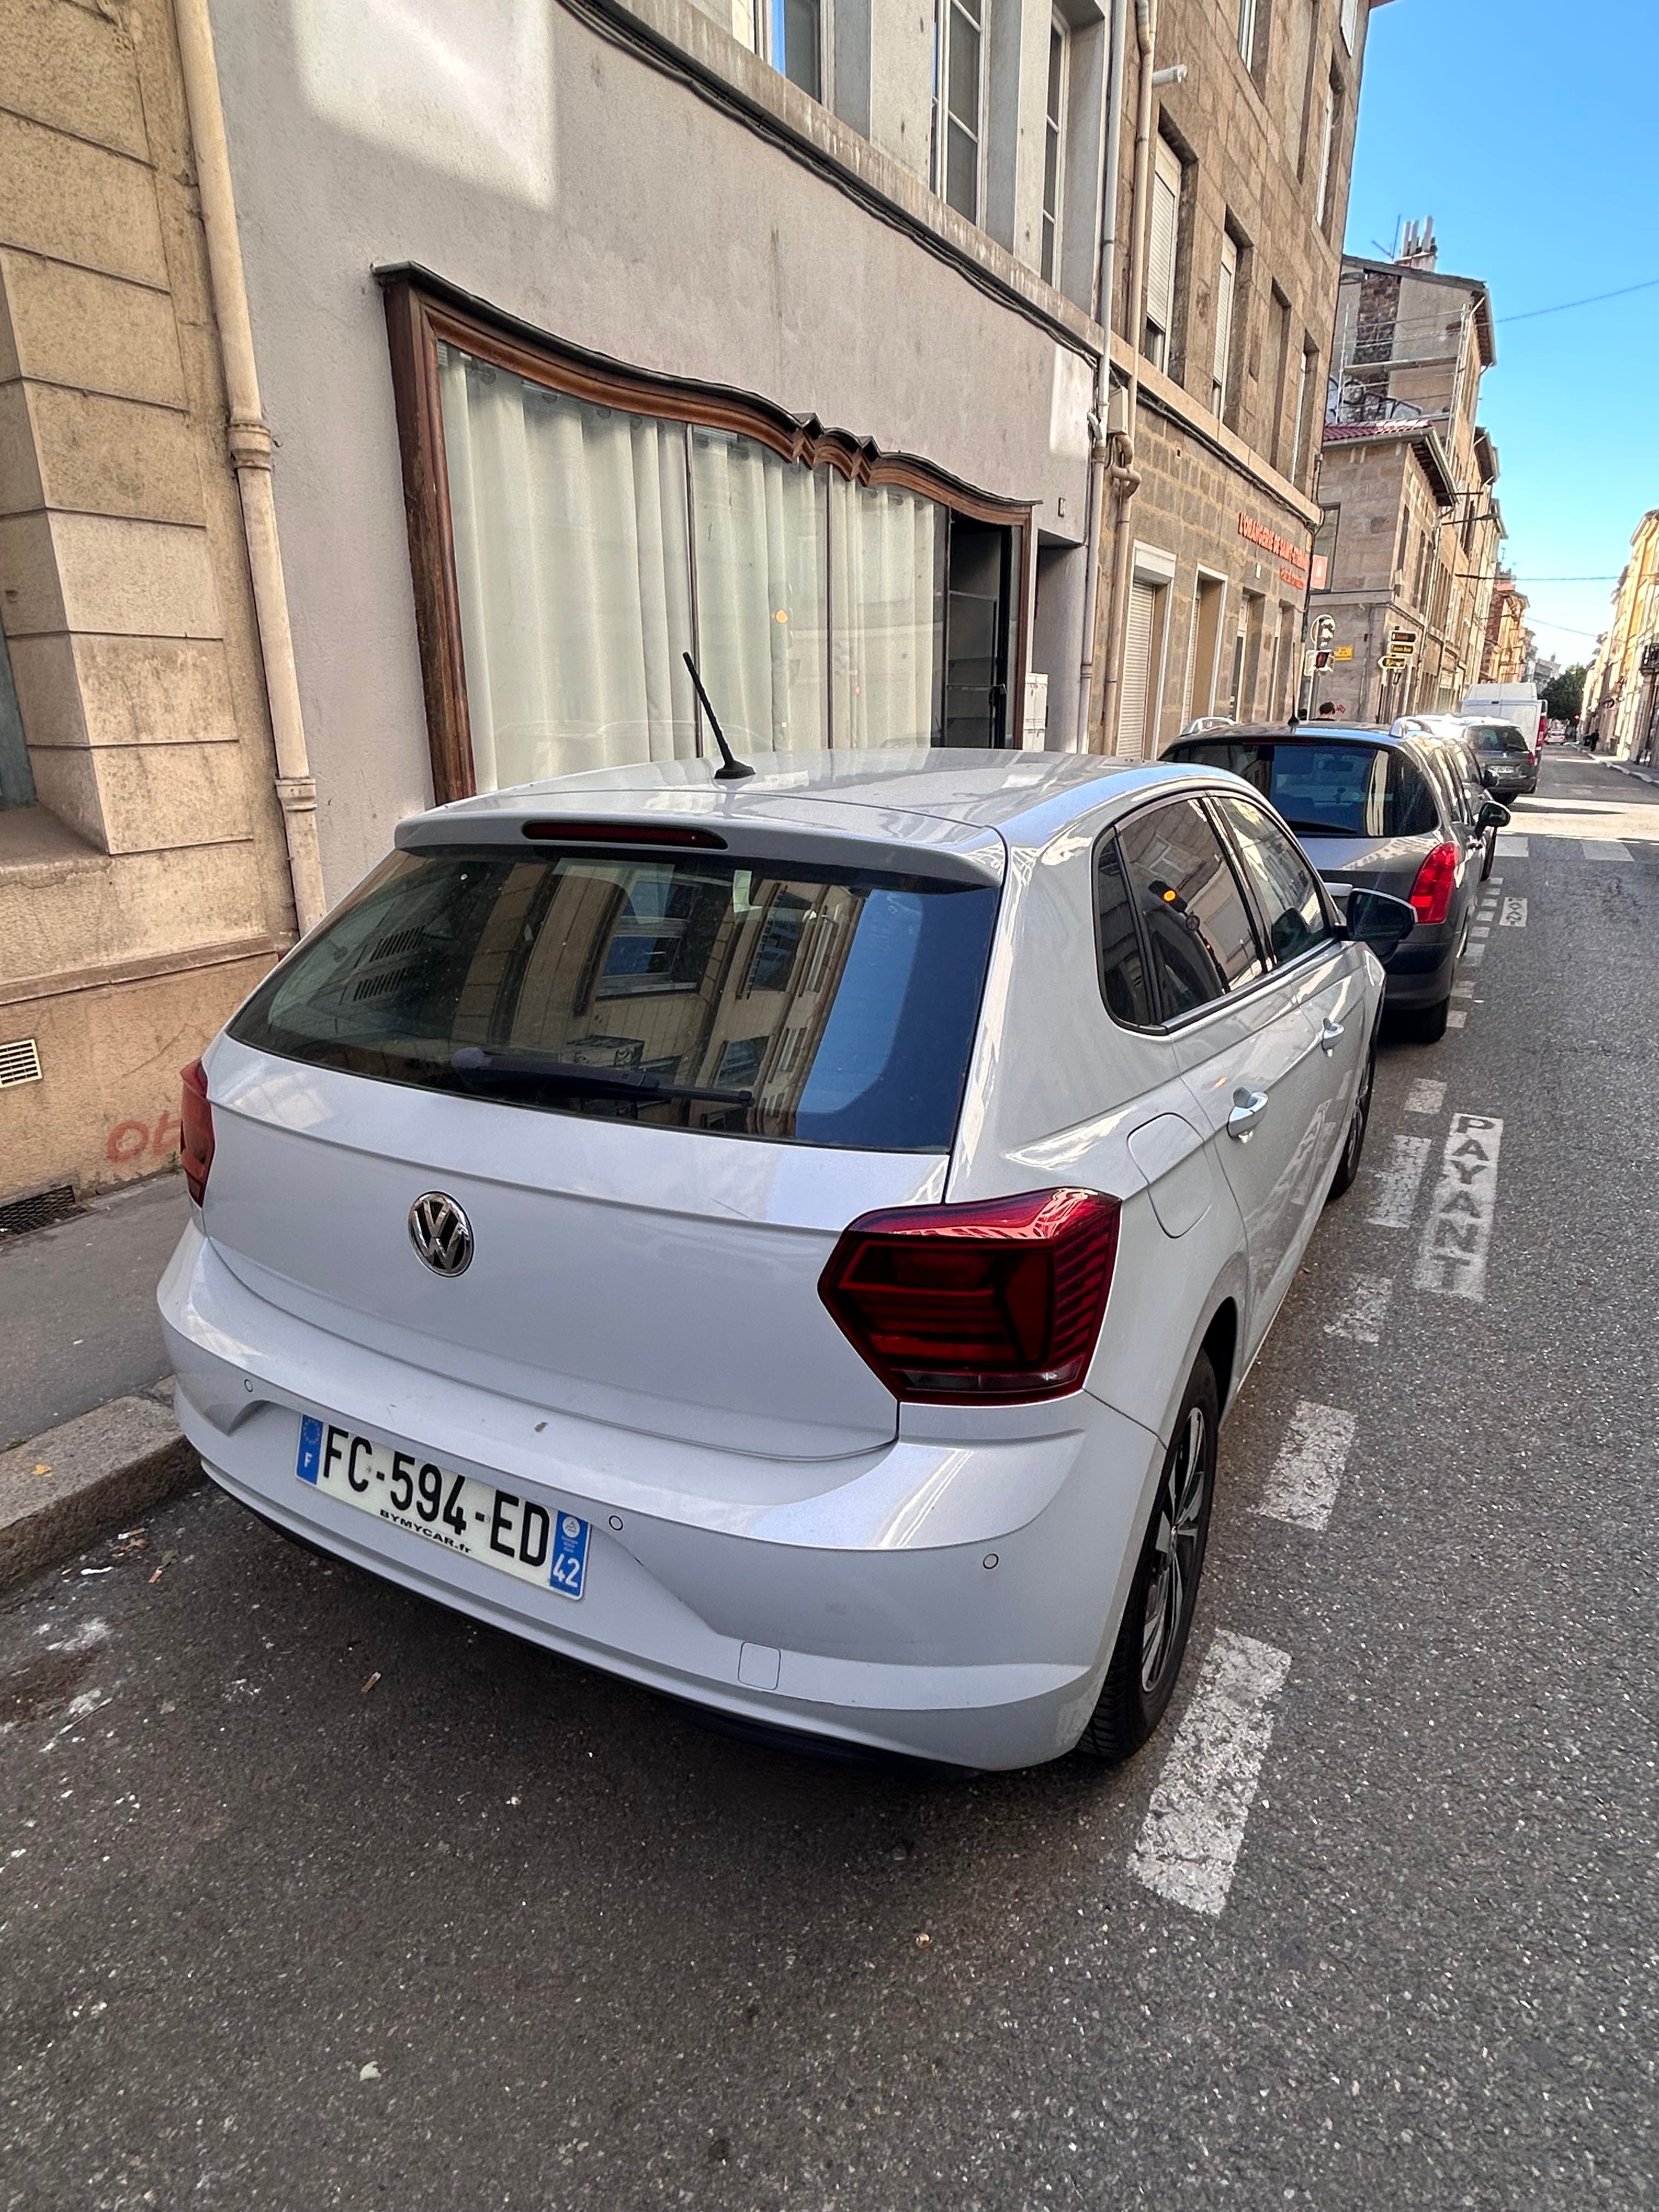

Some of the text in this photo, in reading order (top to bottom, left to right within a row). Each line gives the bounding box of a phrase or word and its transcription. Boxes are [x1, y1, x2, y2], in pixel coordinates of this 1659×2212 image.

[409, 1193, 472, 1276] VW
[1430, 1115, 1496, 1291] PAYANT
[303, 1452, 313, 1468] F
[323, 1424, 549, 1567] FC-594-ED
[379, 1509, 472, 1554] BYMYCAR.fr
[553, 1553, 580, 1588] 42
